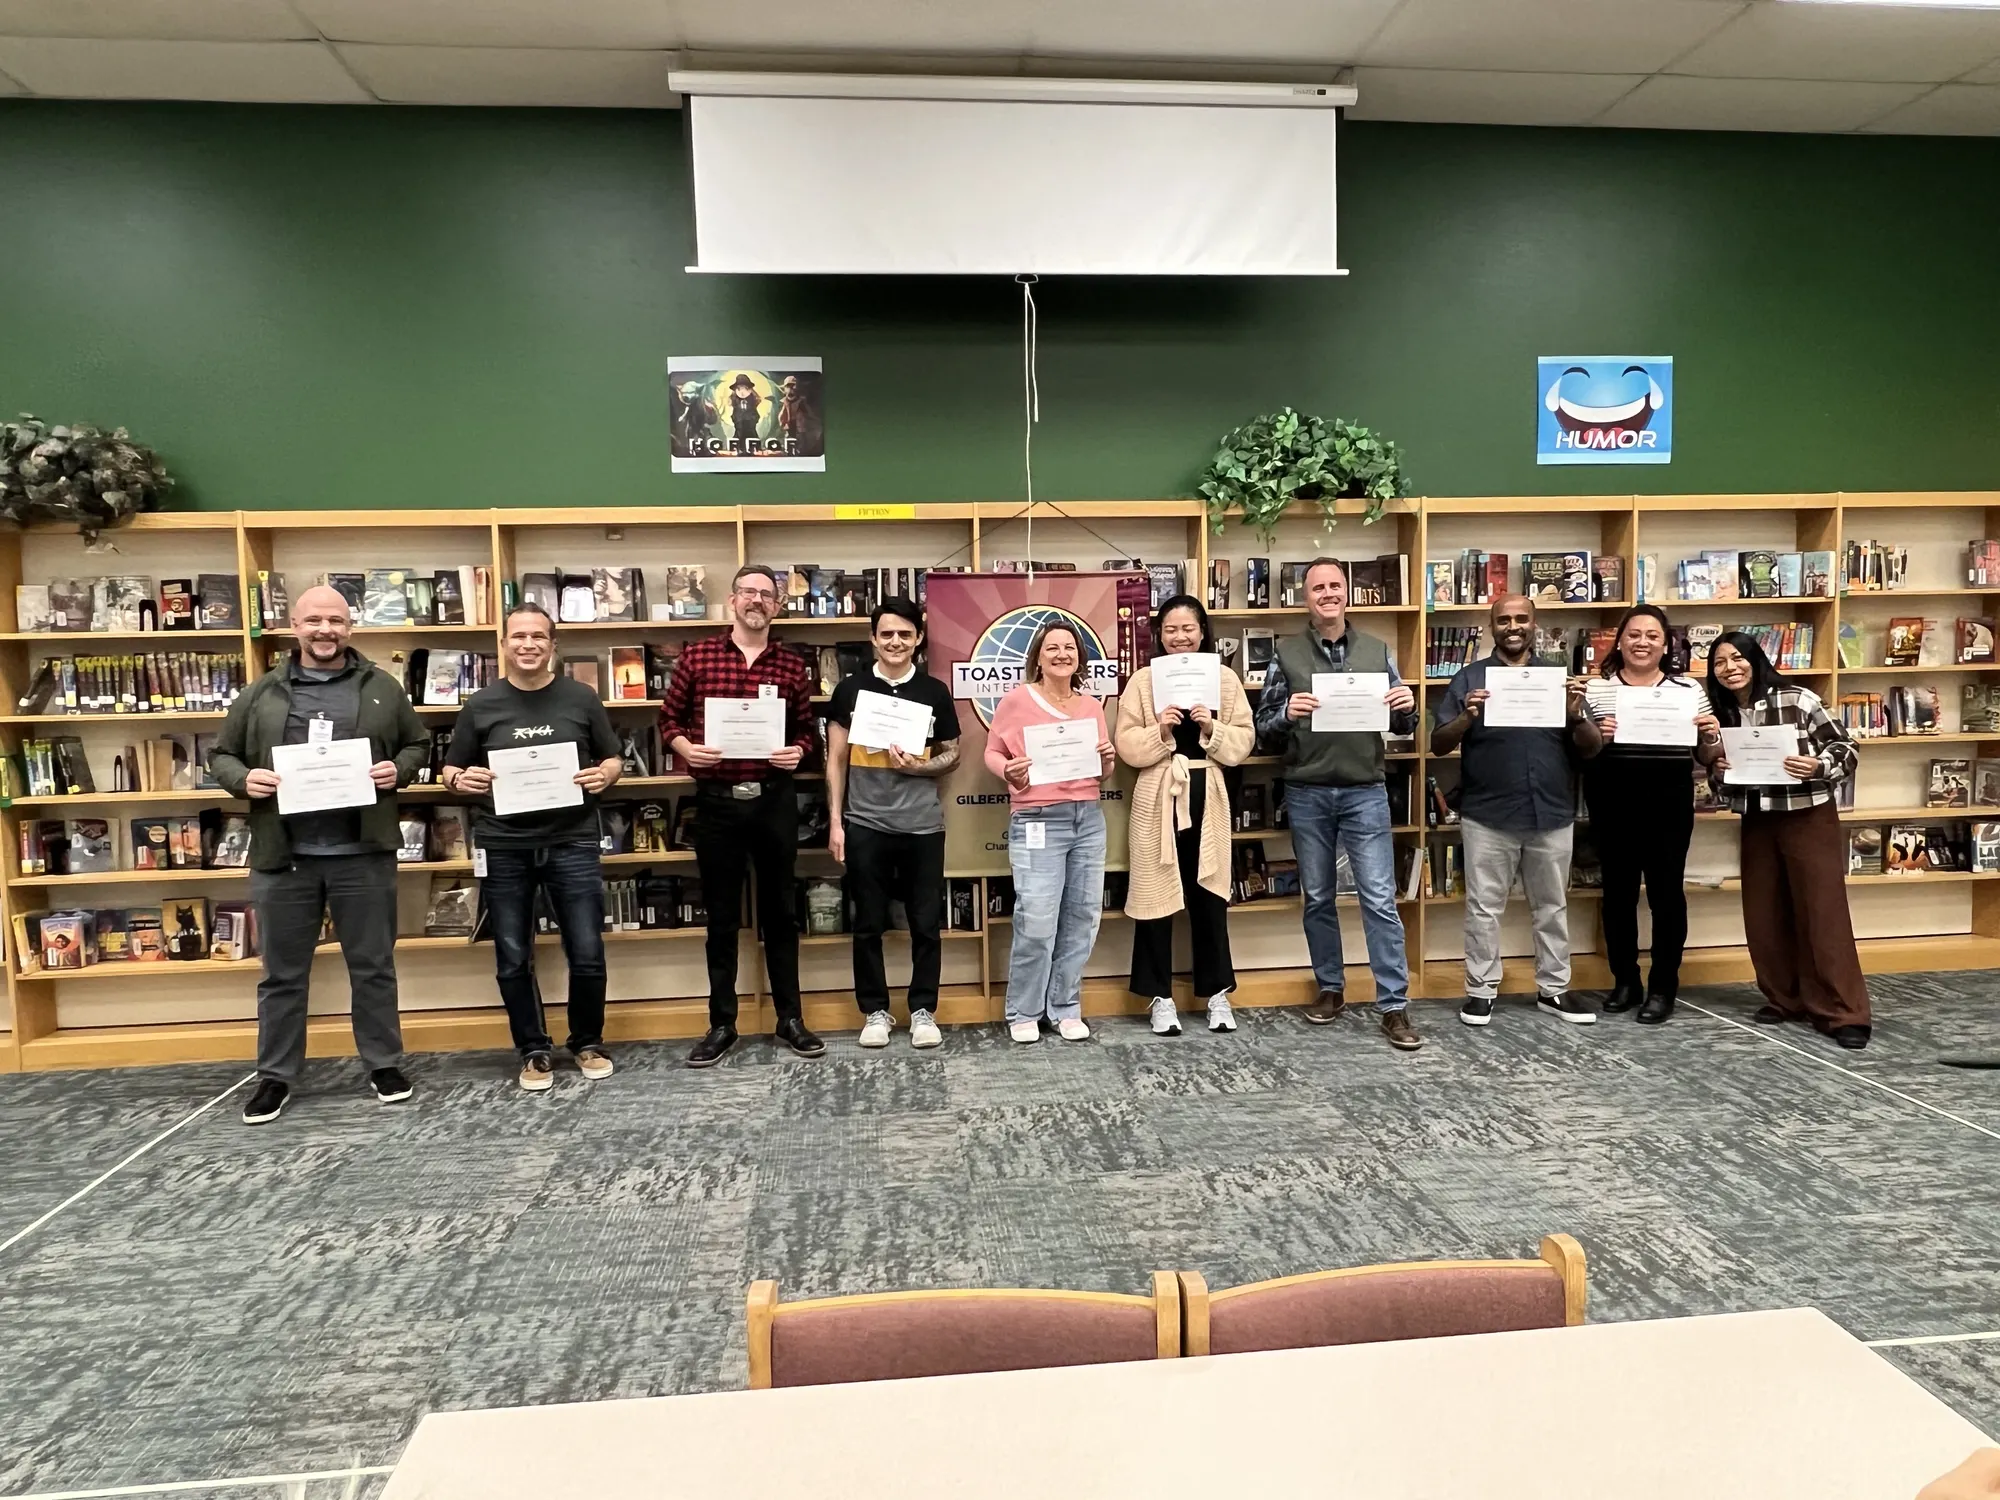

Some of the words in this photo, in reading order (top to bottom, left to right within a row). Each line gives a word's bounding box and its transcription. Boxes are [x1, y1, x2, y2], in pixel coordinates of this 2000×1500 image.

[1555, 430, 1657, 449] HUMOR
[689, 437, 801, 456] HORROR
[858, 508, 890, 516] FICTION
[958, 664, 1119, 682] TOASTERS
[976, 681, 1101, 694] INTERAL
[956, 793, 1010, 805] GILBERT
[985, 842, 1009, 851] Char
